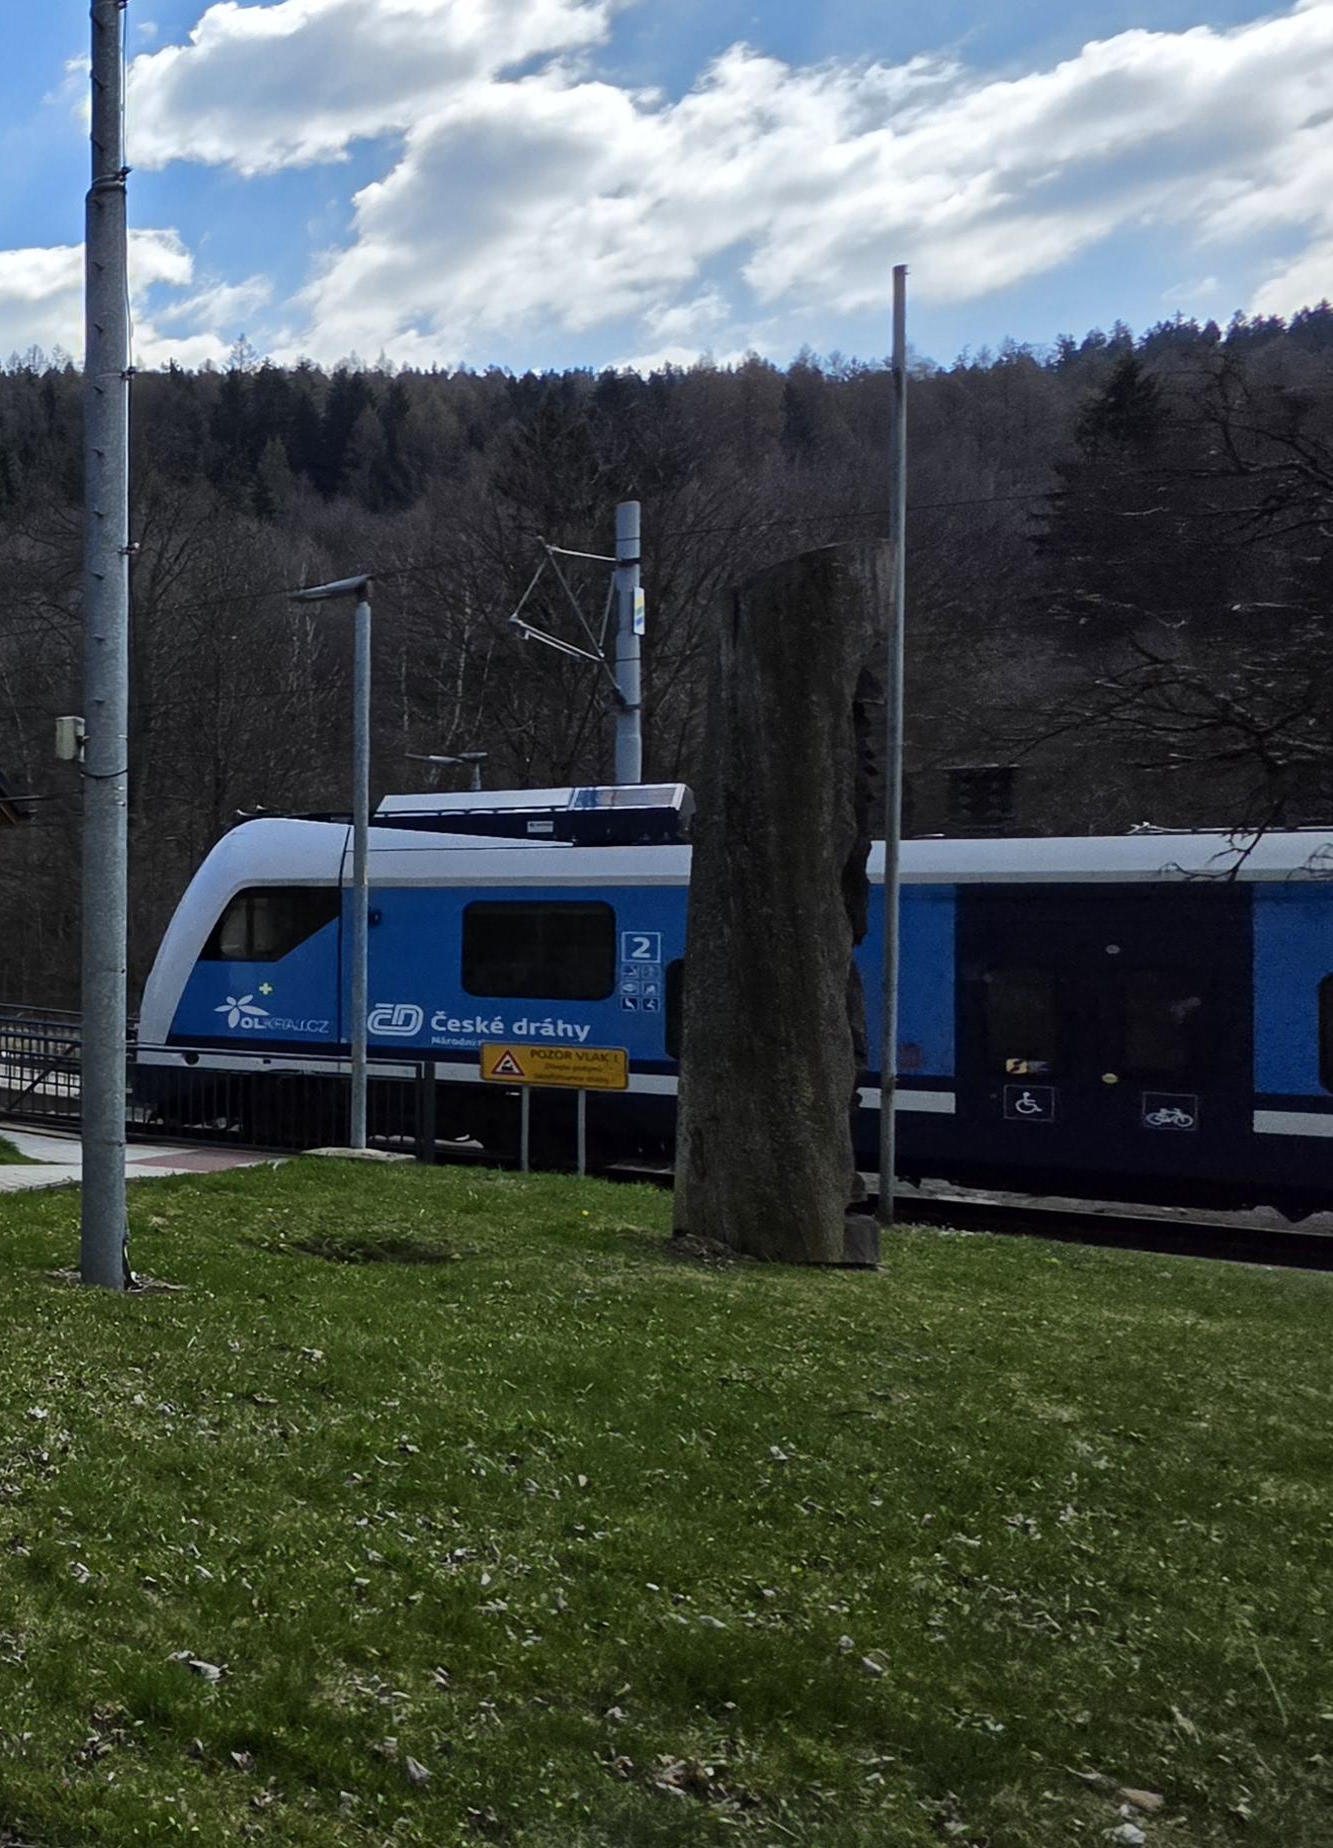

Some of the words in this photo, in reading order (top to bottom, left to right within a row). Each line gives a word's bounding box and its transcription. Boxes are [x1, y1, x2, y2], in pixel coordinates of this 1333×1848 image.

[631, 936, 651, 959] 2
[430, 1011, 505, 1034] České
[512, 1014, 591, 1042] dráhy
[530, 1049, 573, 1062] POZOR
[576, 1051, 609, 1064] VLAK
